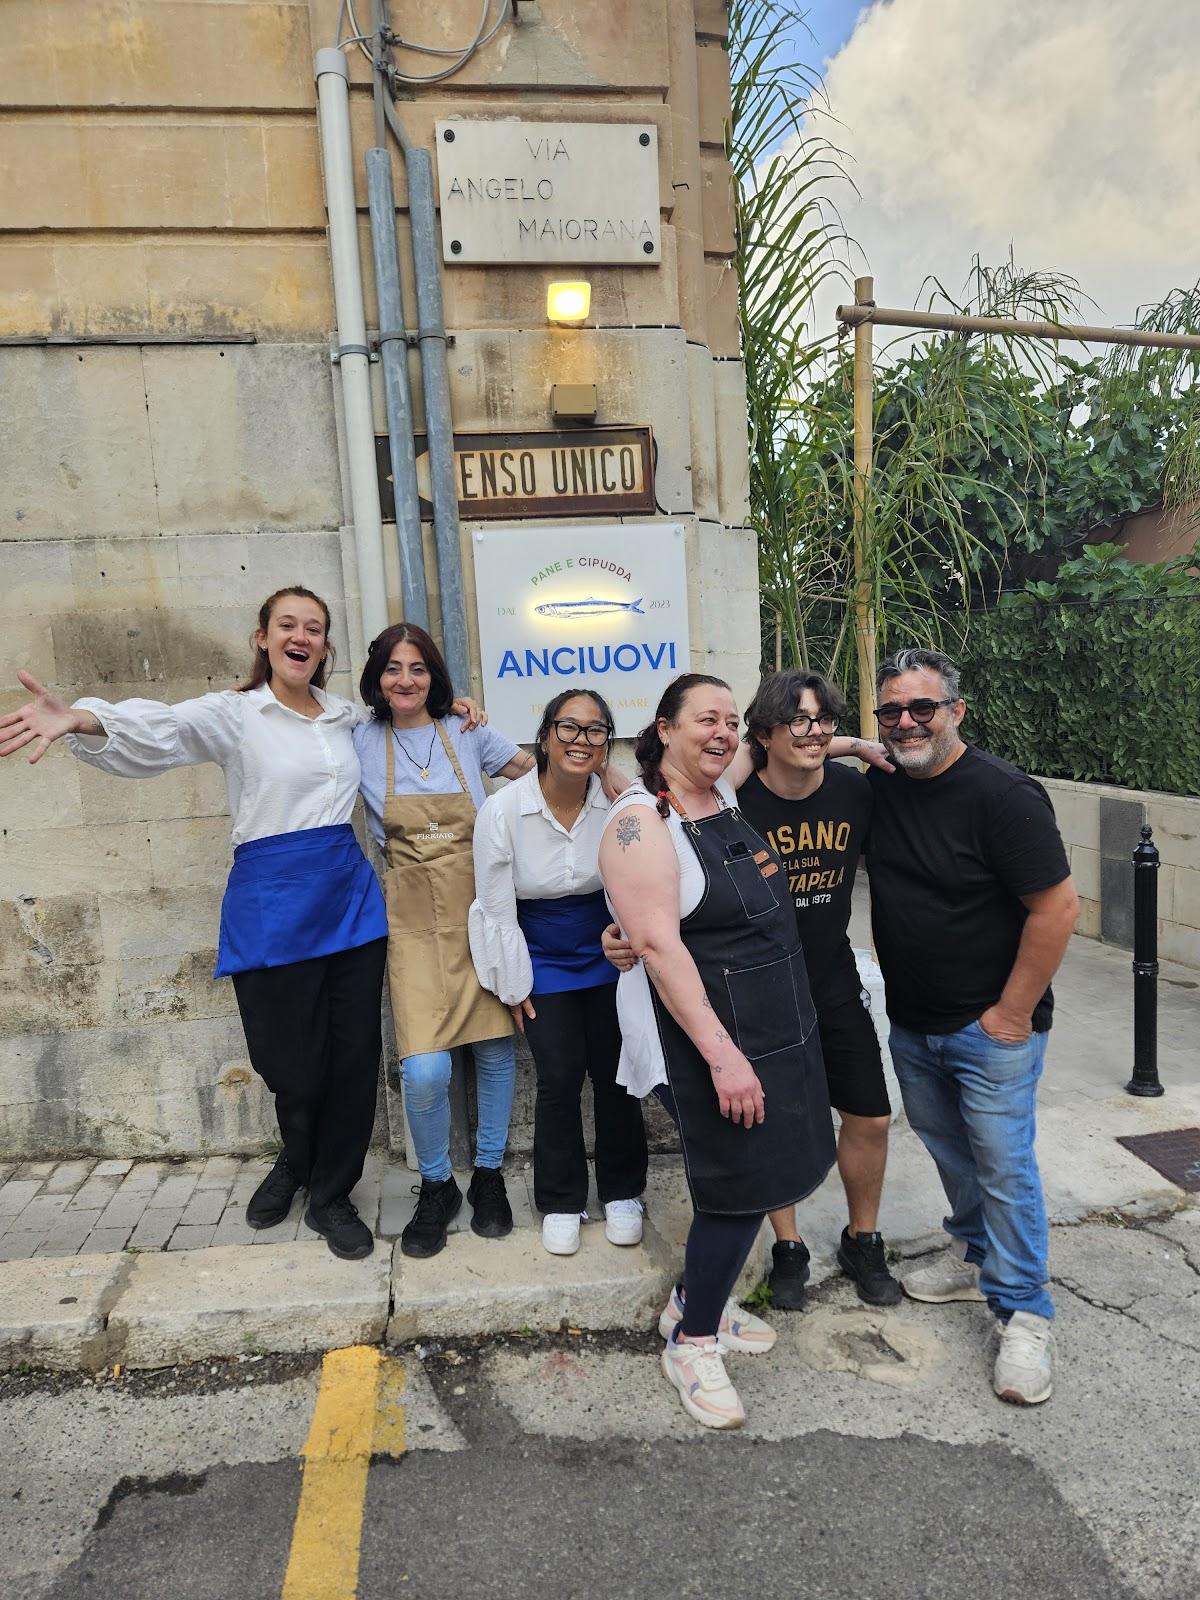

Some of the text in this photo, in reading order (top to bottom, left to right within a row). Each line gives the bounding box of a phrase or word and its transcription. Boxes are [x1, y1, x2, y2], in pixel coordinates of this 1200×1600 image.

[525, 138, 570, 161] VIA
[447, 177, 554, 201] ANGELO
[518, 218, 654, 241] MAIORANA
[459, 446, 636, 499] ENSO UNICO
[530, 557, 633, 587] PANE E CIPUDDA
[649, 599, 671, 609] 2023
[497, 642, 677, 679] ANCIUOVI
[416, 832, 455, 840] FIRRIATO
[766, 820, 851, 855] ISANO
[788, 859, 800, 871] LA
[801, 856, 821, 868] SUA
[795, 893, 832, 908] DAL 1972
